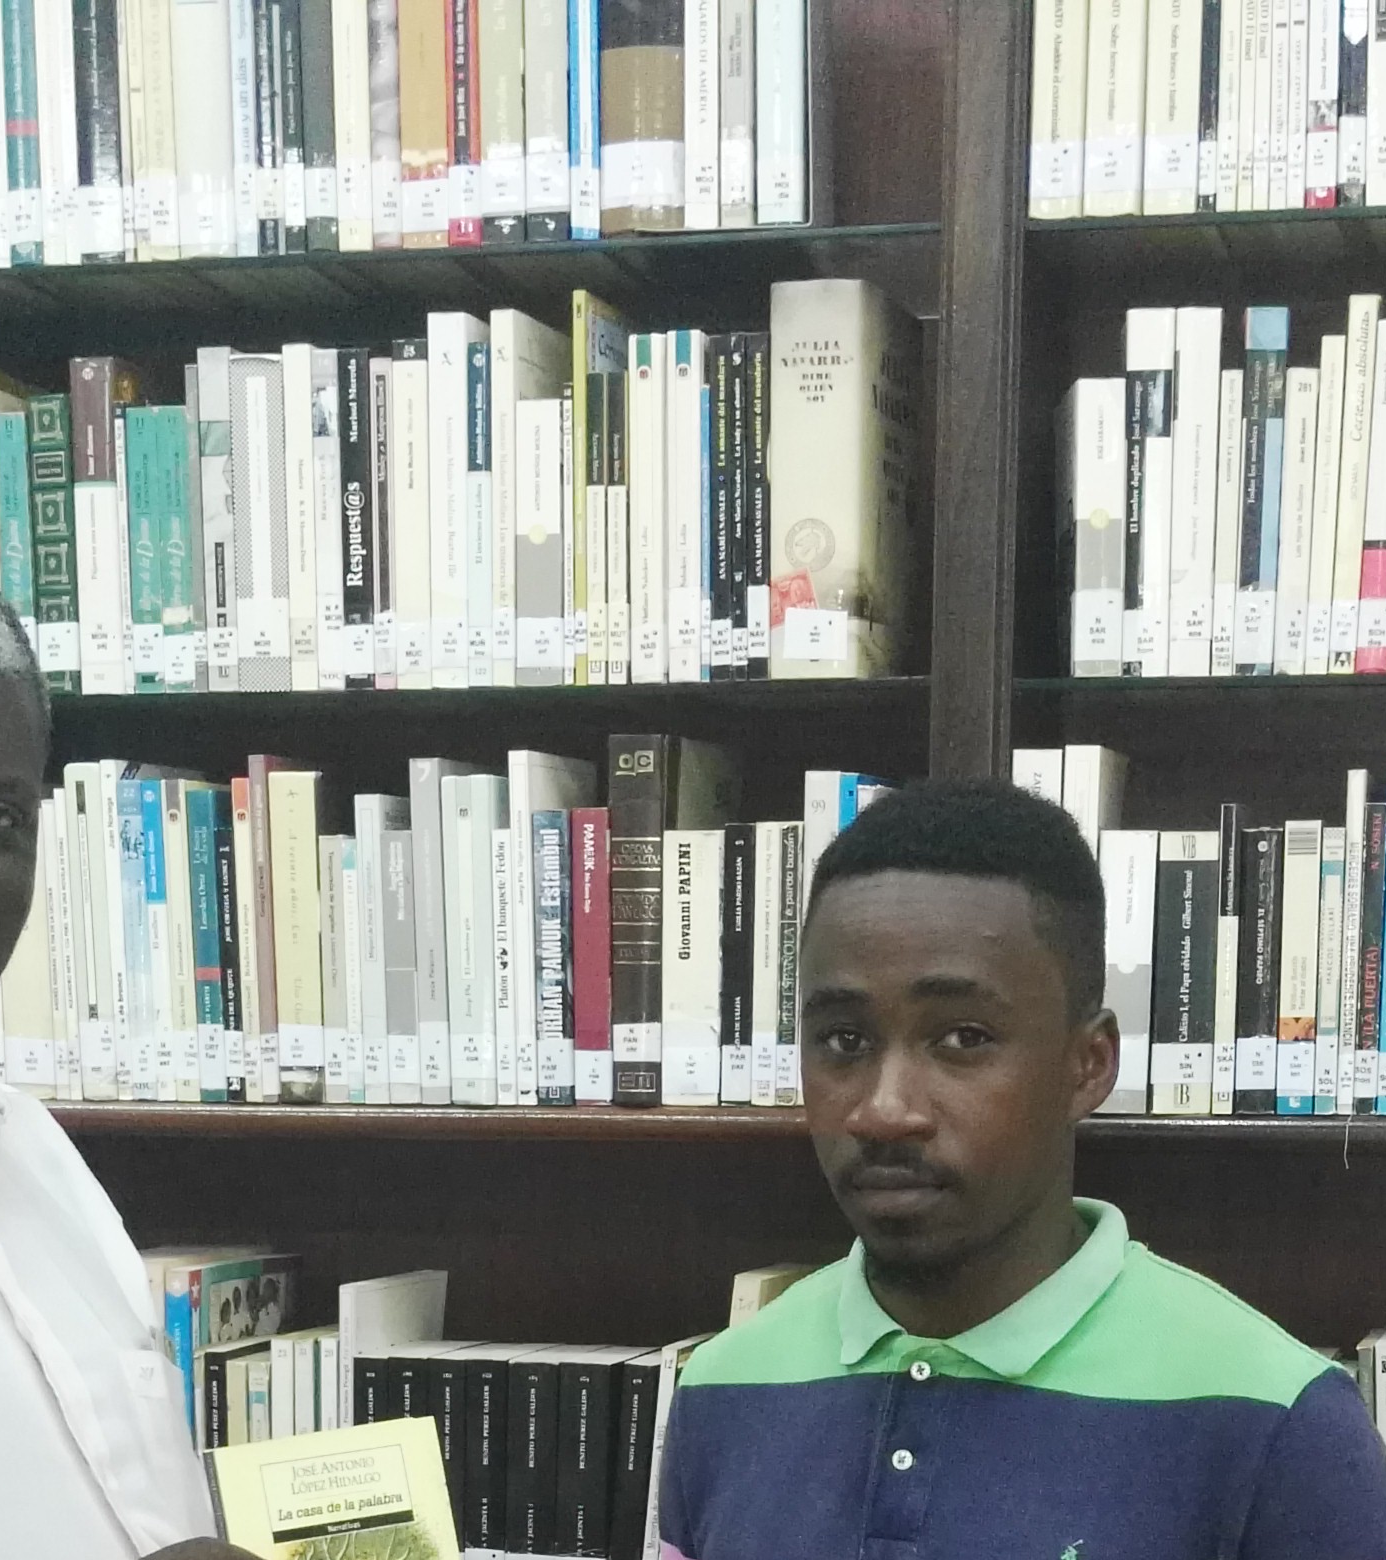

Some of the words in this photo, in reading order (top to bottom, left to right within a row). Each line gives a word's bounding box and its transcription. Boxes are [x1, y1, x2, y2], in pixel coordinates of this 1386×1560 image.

[1356, 310, 1371, 377] absolutas
[717, 400, 726, 417] del
[1349, 382, 1367, 442] Certezas
[717, 420, 726, 453] amante
[717, 455, 726, 466] La
[1129, 445, 1141, 487] duplicado
[1129, 489, 1140, 522] hombre
[344, 482, 365, 587] Respuest@s
[1129, 523, 1139, 534] El
[717, 560, 727, 580] ANA
[810, 798, 827, 814] 99
[582, 823, 596, 871] PAMUK
[536, 828, 562, 906] Estambul
[677, 842, 692, 895] PAPINI
[677, 900, 692, 960] Giovanni
[540, 918, 564, 980] PAMUK
[290, 1479, 326, 1495] LÓPEZ
[328, 1472, 381, 1490] HIDALGO
[292, 1464, 319, 1481] JOSÉ
[321, 1456, 375, 1475] ANTONIO
[278, 1509, 293, 1522] La
[296, 1506, 323, 1519] casa
[326, 1501, 342, 1514] de
[345, 1498, 356, 1511] la
[358, 1492, 403, 1512] palabra
